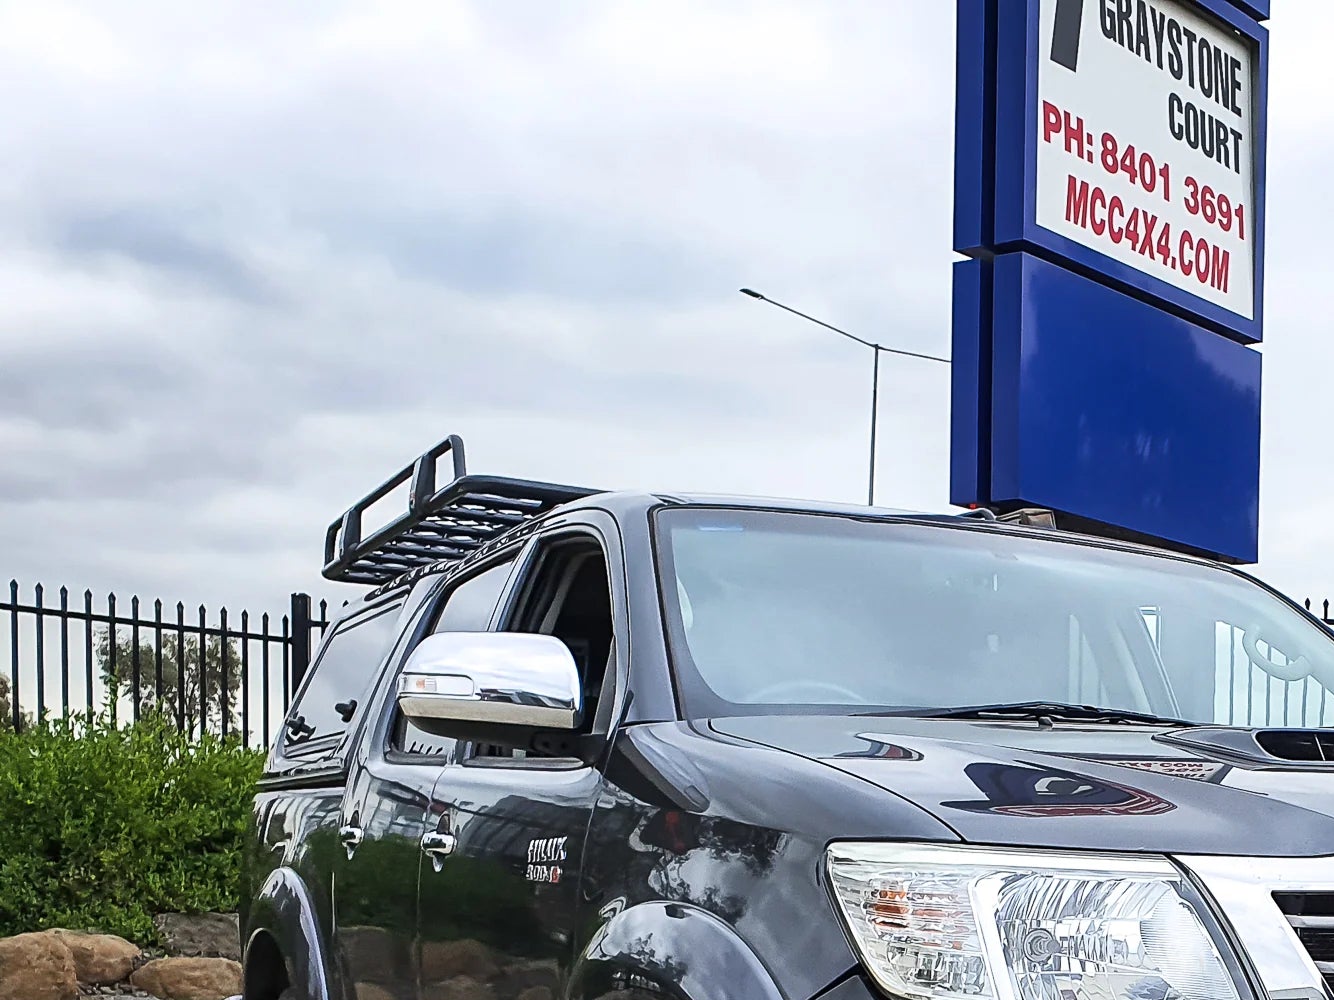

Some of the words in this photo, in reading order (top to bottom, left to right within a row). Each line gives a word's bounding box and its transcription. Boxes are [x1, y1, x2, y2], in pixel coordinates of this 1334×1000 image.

[1100, 0, 1242, 117] GRAYSTONE
[1043, 100, 1094, 163] PH:
[1101, 132, 1170, 202] 8401
[1184, 176, 1245, 240] 3691
[1168, 93, 1243, 174] COURT
[1065, 174, 1229, 293] MCC4X4.COM
